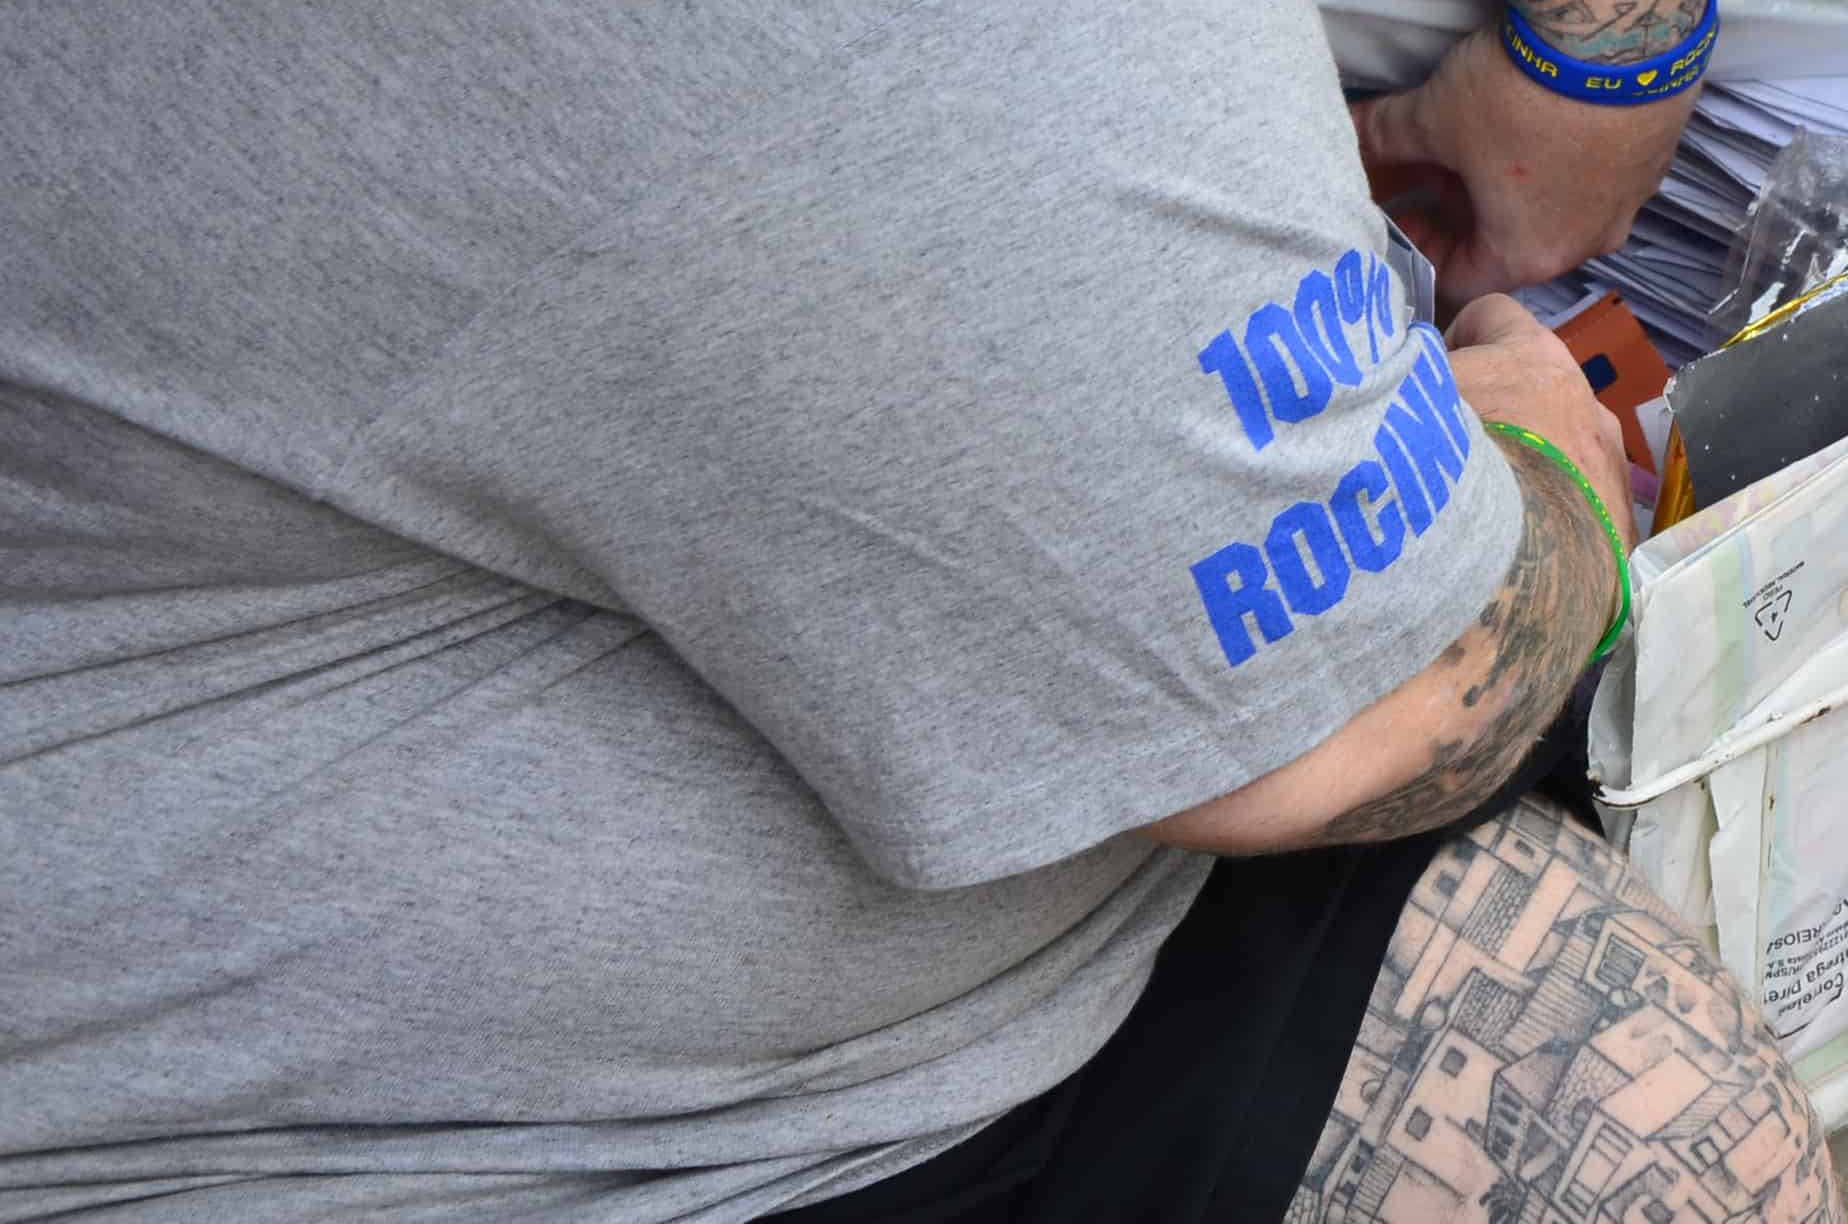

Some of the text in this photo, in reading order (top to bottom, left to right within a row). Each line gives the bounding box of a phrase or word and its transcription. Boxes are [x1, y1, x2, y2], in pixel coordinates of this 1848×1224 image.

[1585, 76, 1623, 89] EU
[1197, 248, 1395, 452] 100%
[1190, 321, 1471, 668] ROCINH
